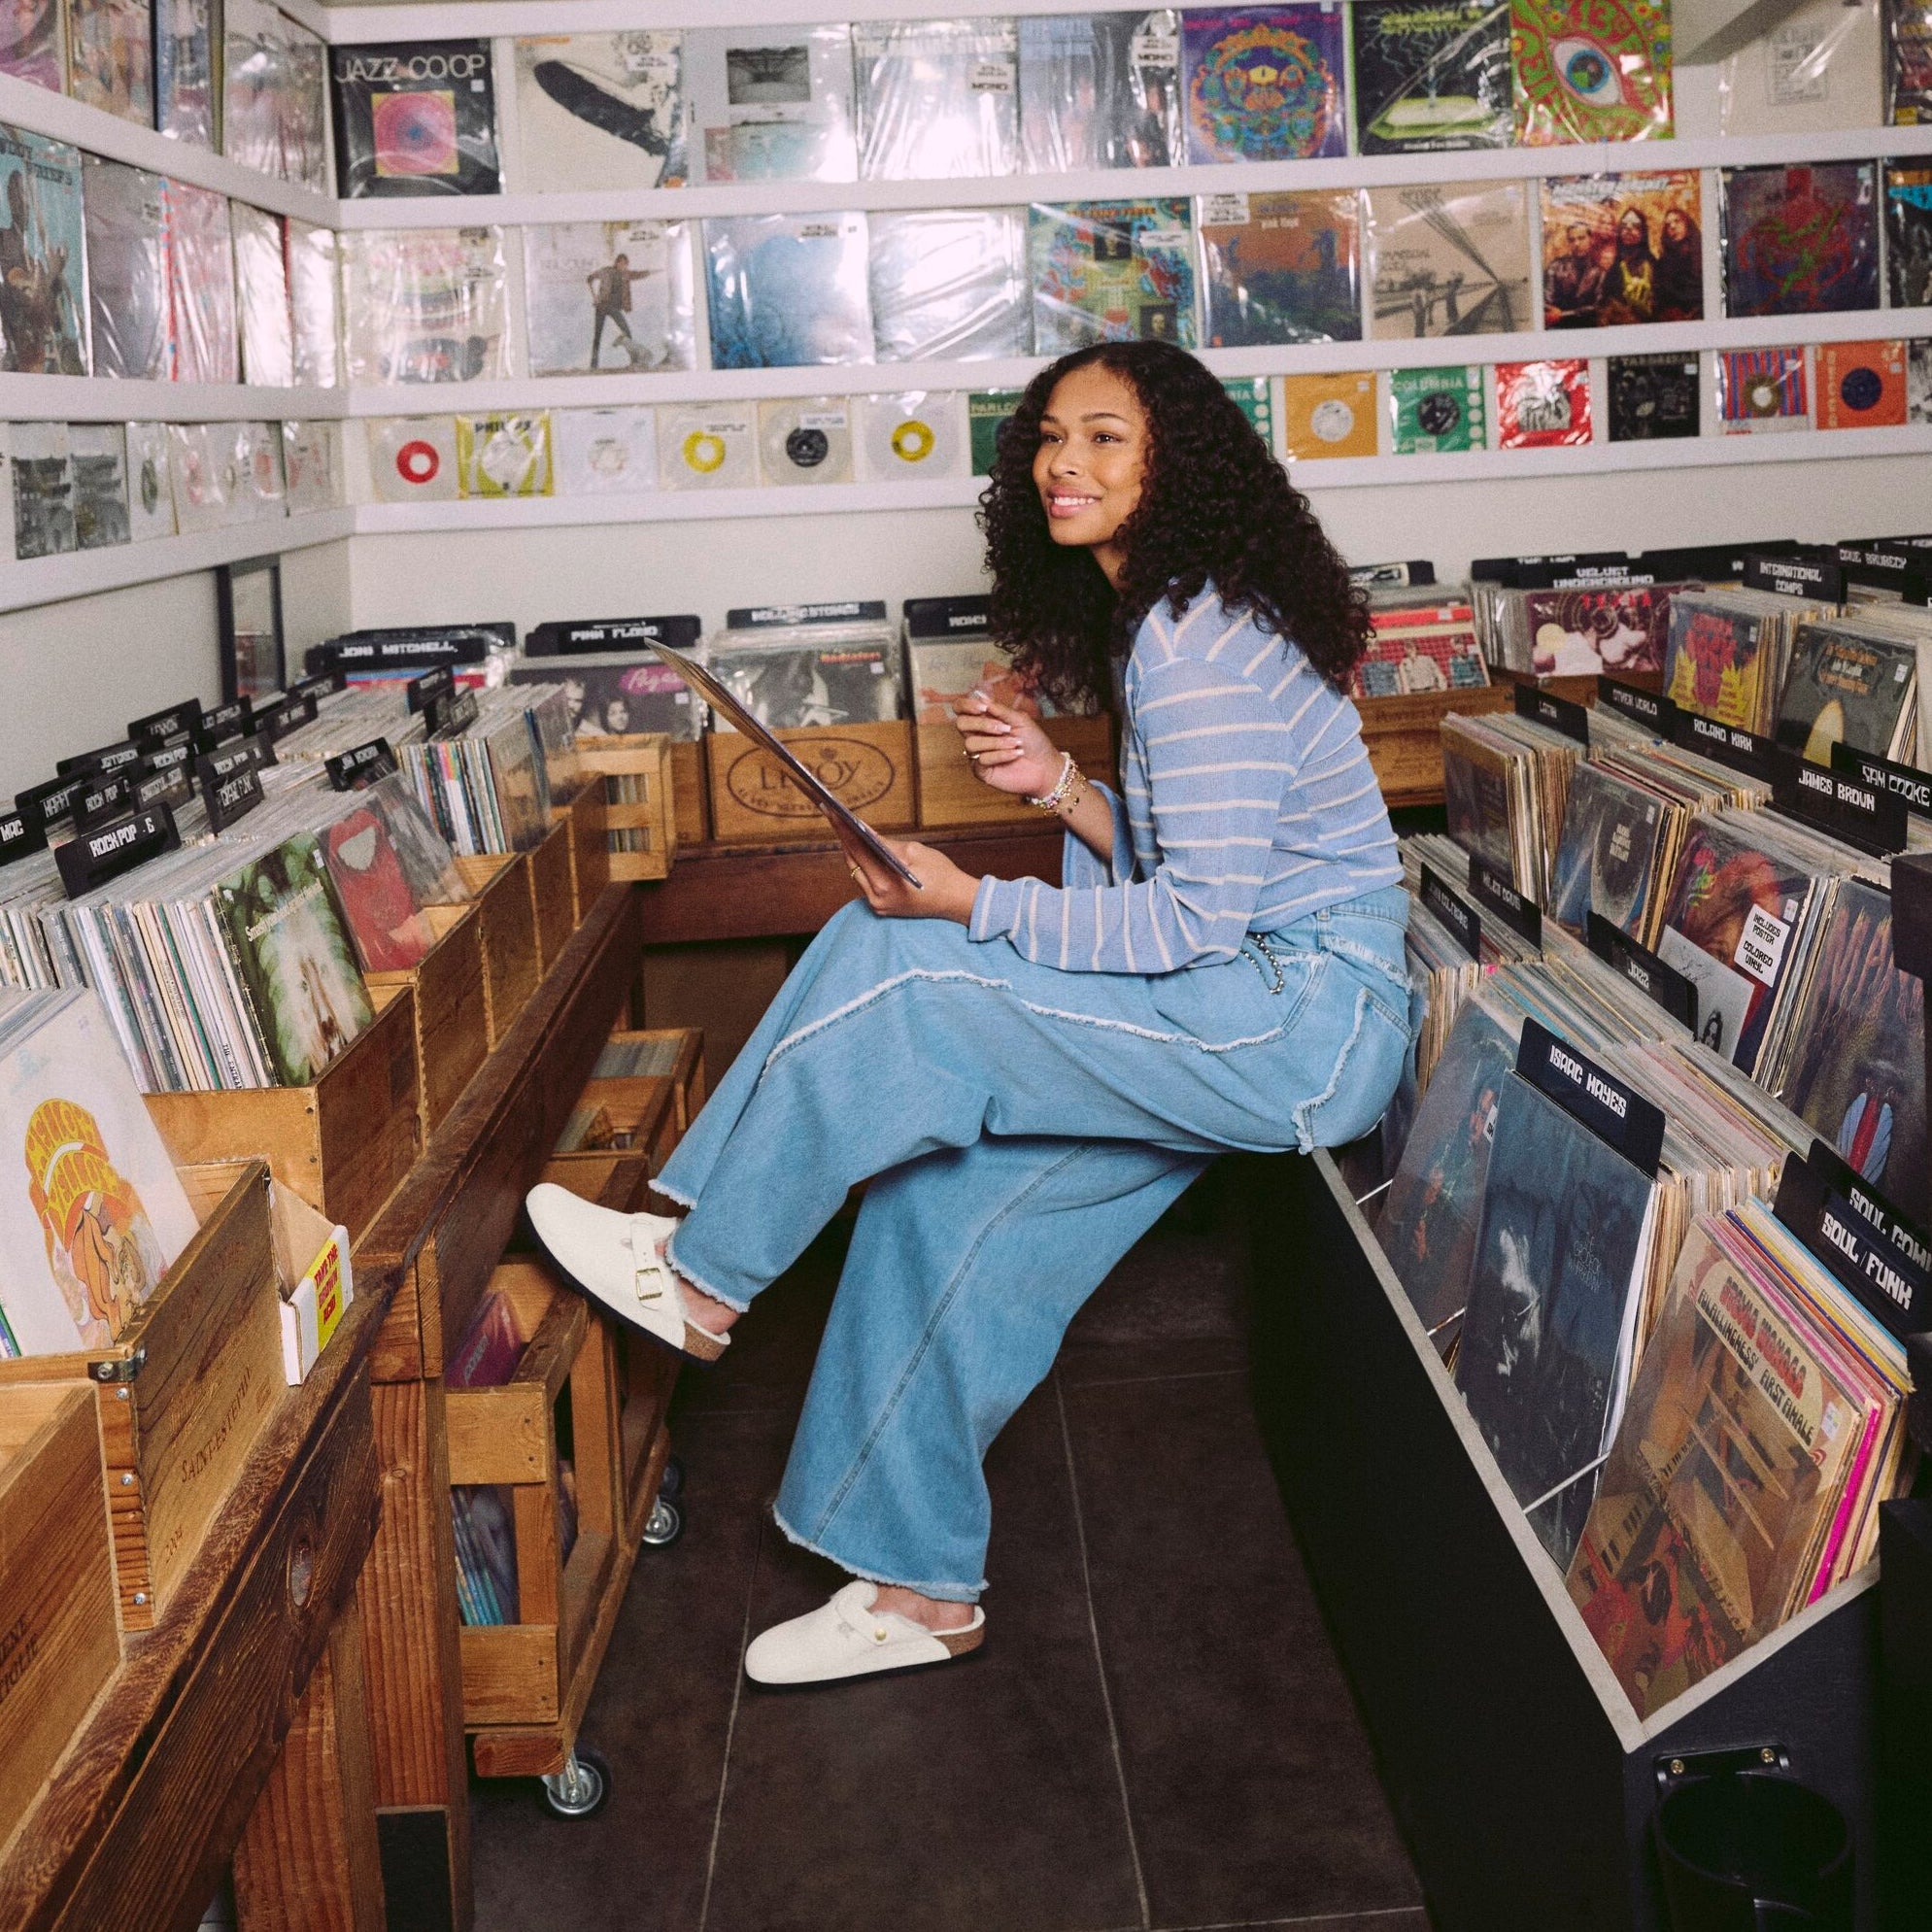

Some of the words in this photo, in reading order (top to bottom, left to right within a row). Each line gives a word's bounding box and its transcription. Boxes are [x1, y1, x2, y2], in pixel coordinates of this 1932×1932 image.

[334, 56, 399, 83] JAZZ
[1576, 565, 1630, 578] VELVET
[1760, 561, 1822, 583] INTERNATIONAL
[571, 629, 605, 642] PINK
[612, 626, 659, 639] FLOYD
[339, 645, 374, 659] JONI
[1693, 718, 1727, 742] ROLAND
[1731, 731, 1753, 753] KIRK
[1798, 768, 1833, 796] JAMES
[1837, 783, 1876, 813] BROWN
[1861, 764, 1886, 789] SAM
[1888, 774, 1932, 807] COOKE
[89, 830, 119, 859] ROCK
[117, 823, 138, 850] POP
[1751, 924, 1776, 946] POSTER
[1752, 913, 1781, 938] INCLUDES
[1743, 940, 1774, 968] COLORED
[1745, 954, 1764, 974] VINYL
[1549, 1044, 1583, 1085] ISAAC
[1585, 1072, 1628, 1119] HAYES
[1849, 1187, 1887, 1236] SOUL
[1759, 1369, 1786, 1408] FIRST
[1781, 1401, 1814, 1447] FINALE
